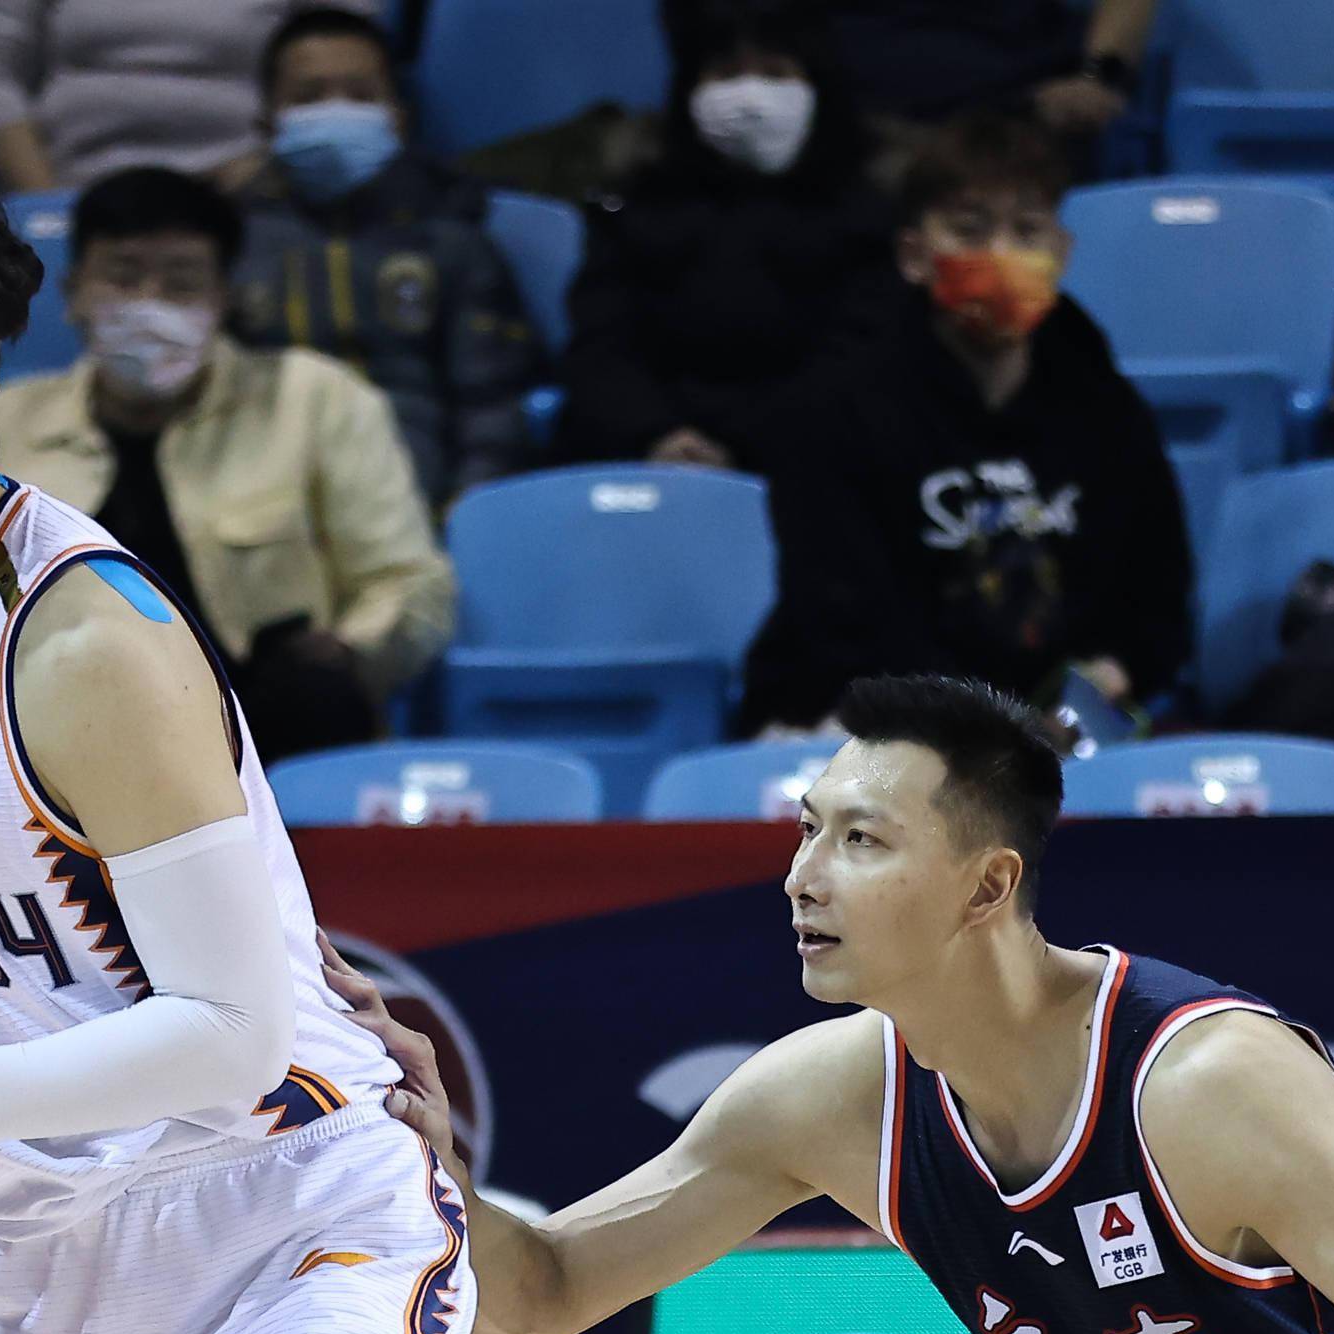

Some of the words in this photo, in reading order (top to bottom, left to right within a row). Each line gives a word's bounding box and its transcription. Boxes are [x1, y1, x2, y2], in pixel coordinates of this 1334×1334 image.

[1100, 1243, 1148, 1268] 广发银行
[1113, 1261, 1144, 1280] CGB
